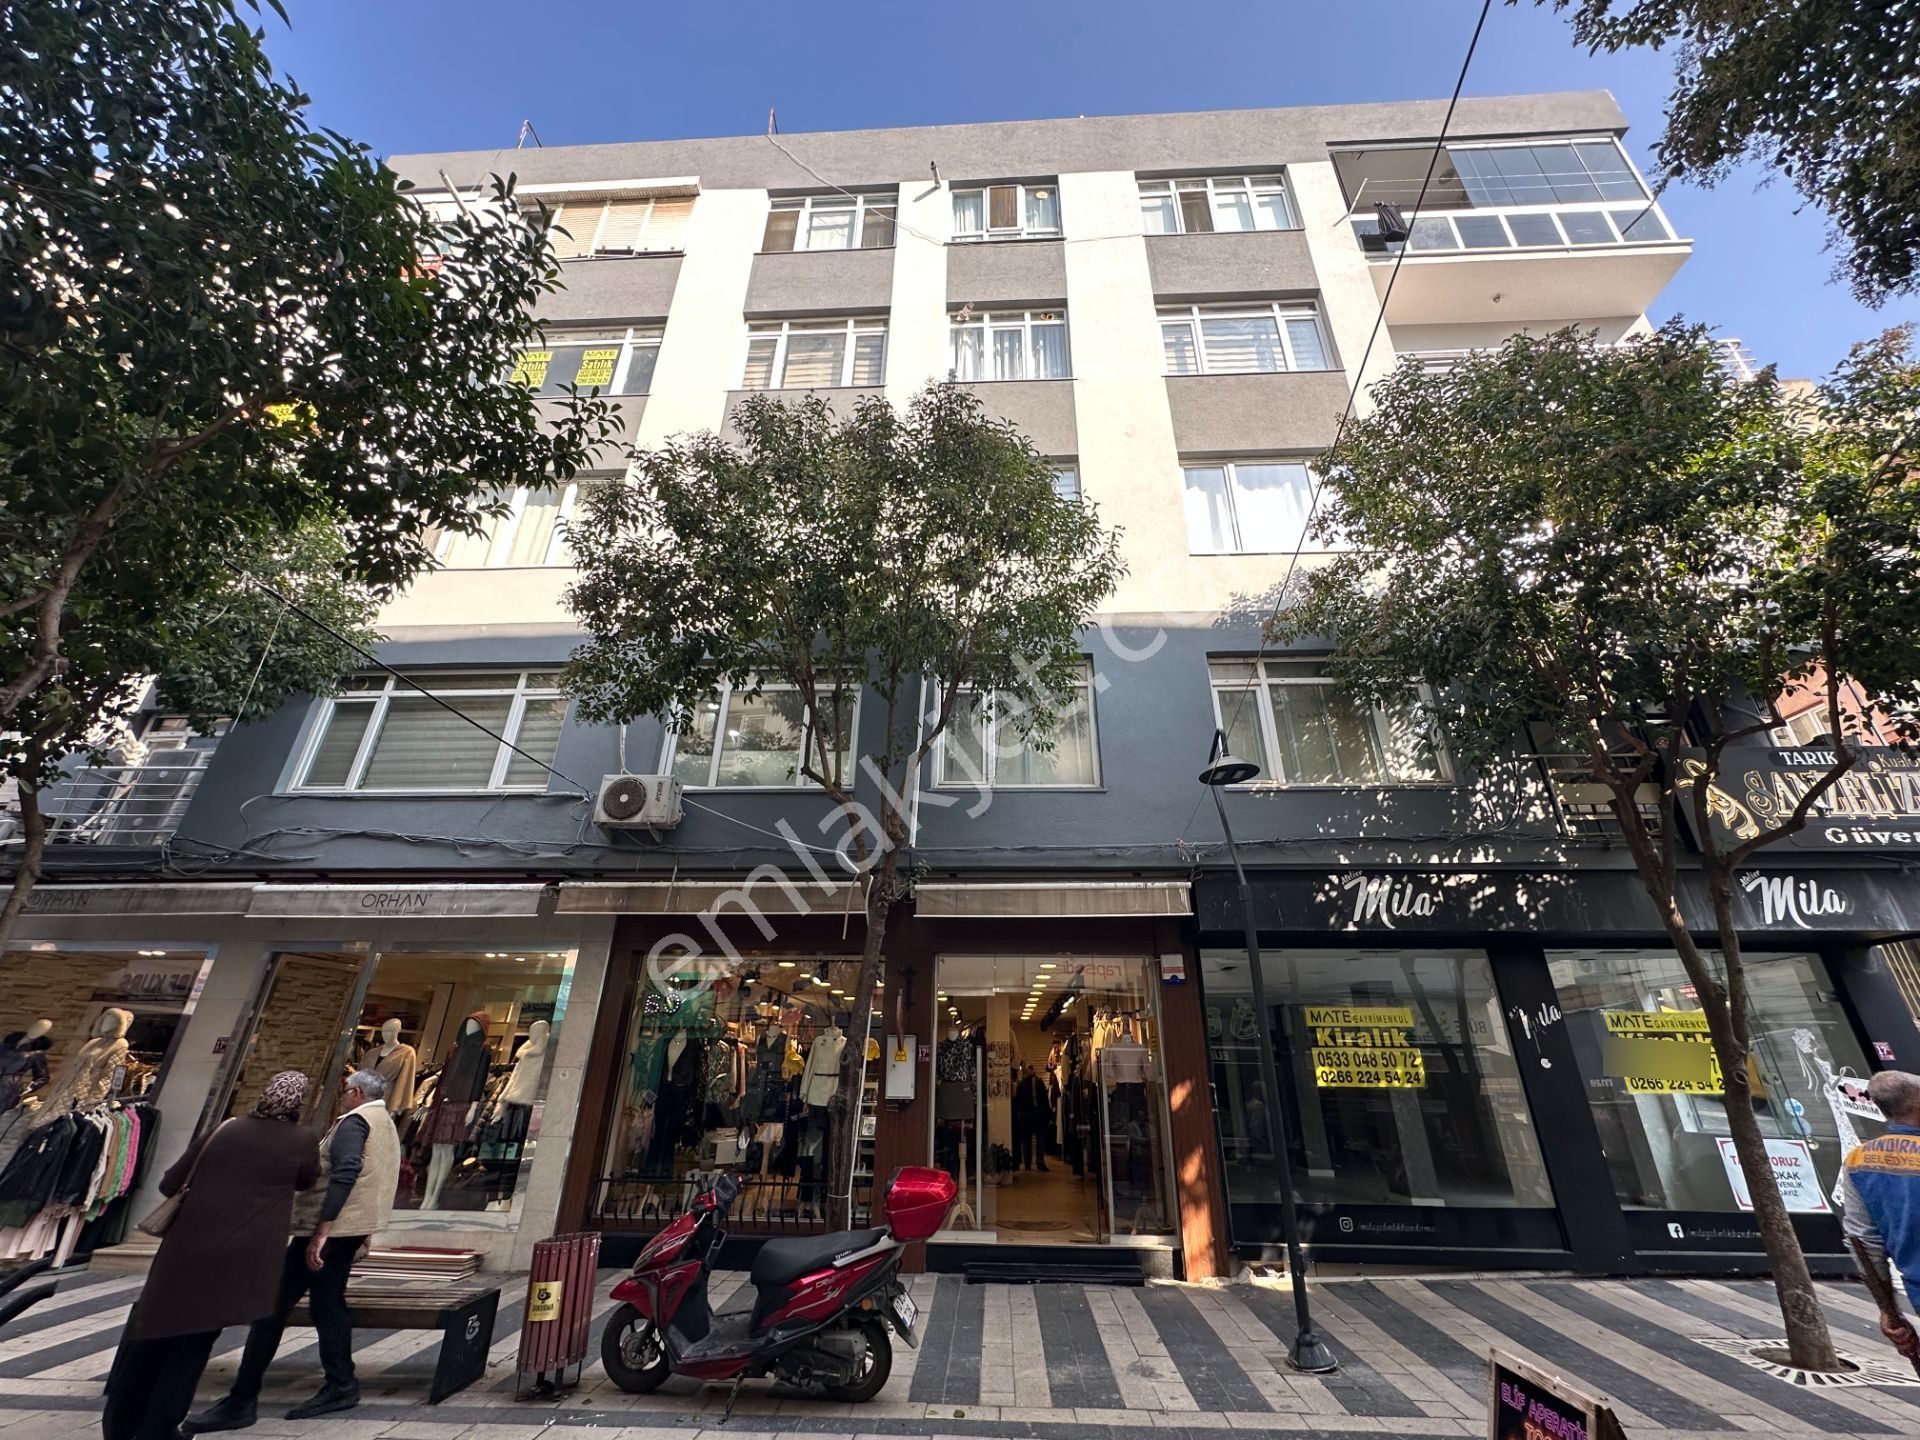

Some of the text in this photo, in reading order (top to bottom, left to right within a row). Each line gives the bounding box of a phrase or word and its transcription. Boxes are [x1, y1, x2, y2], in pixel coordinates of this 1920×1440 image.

[1778, 751, 1839, 766] TARIK
[1340, 870, 1363, 885] Atelier
[1740, 870, 1760, 887] Atelier
[361, 893, 428, 908] ORHAN
[1343, 876, 1436, 929] Mila
[1746, 876, 1846, 929] Mila
[1310, 1010, 1352, 1024] MATE
[1608, 1015, 1708, 1029] MATE GAYRİMENKU
[1315, 1027, 1411, 1048] Kiralık
[1318, 1052, 1419, 1067] 0533 048 50 72
[1321, 1071, 1421, 1084] 0266 224 54 24
[1630, 1077, 1664, 1090] 0266
